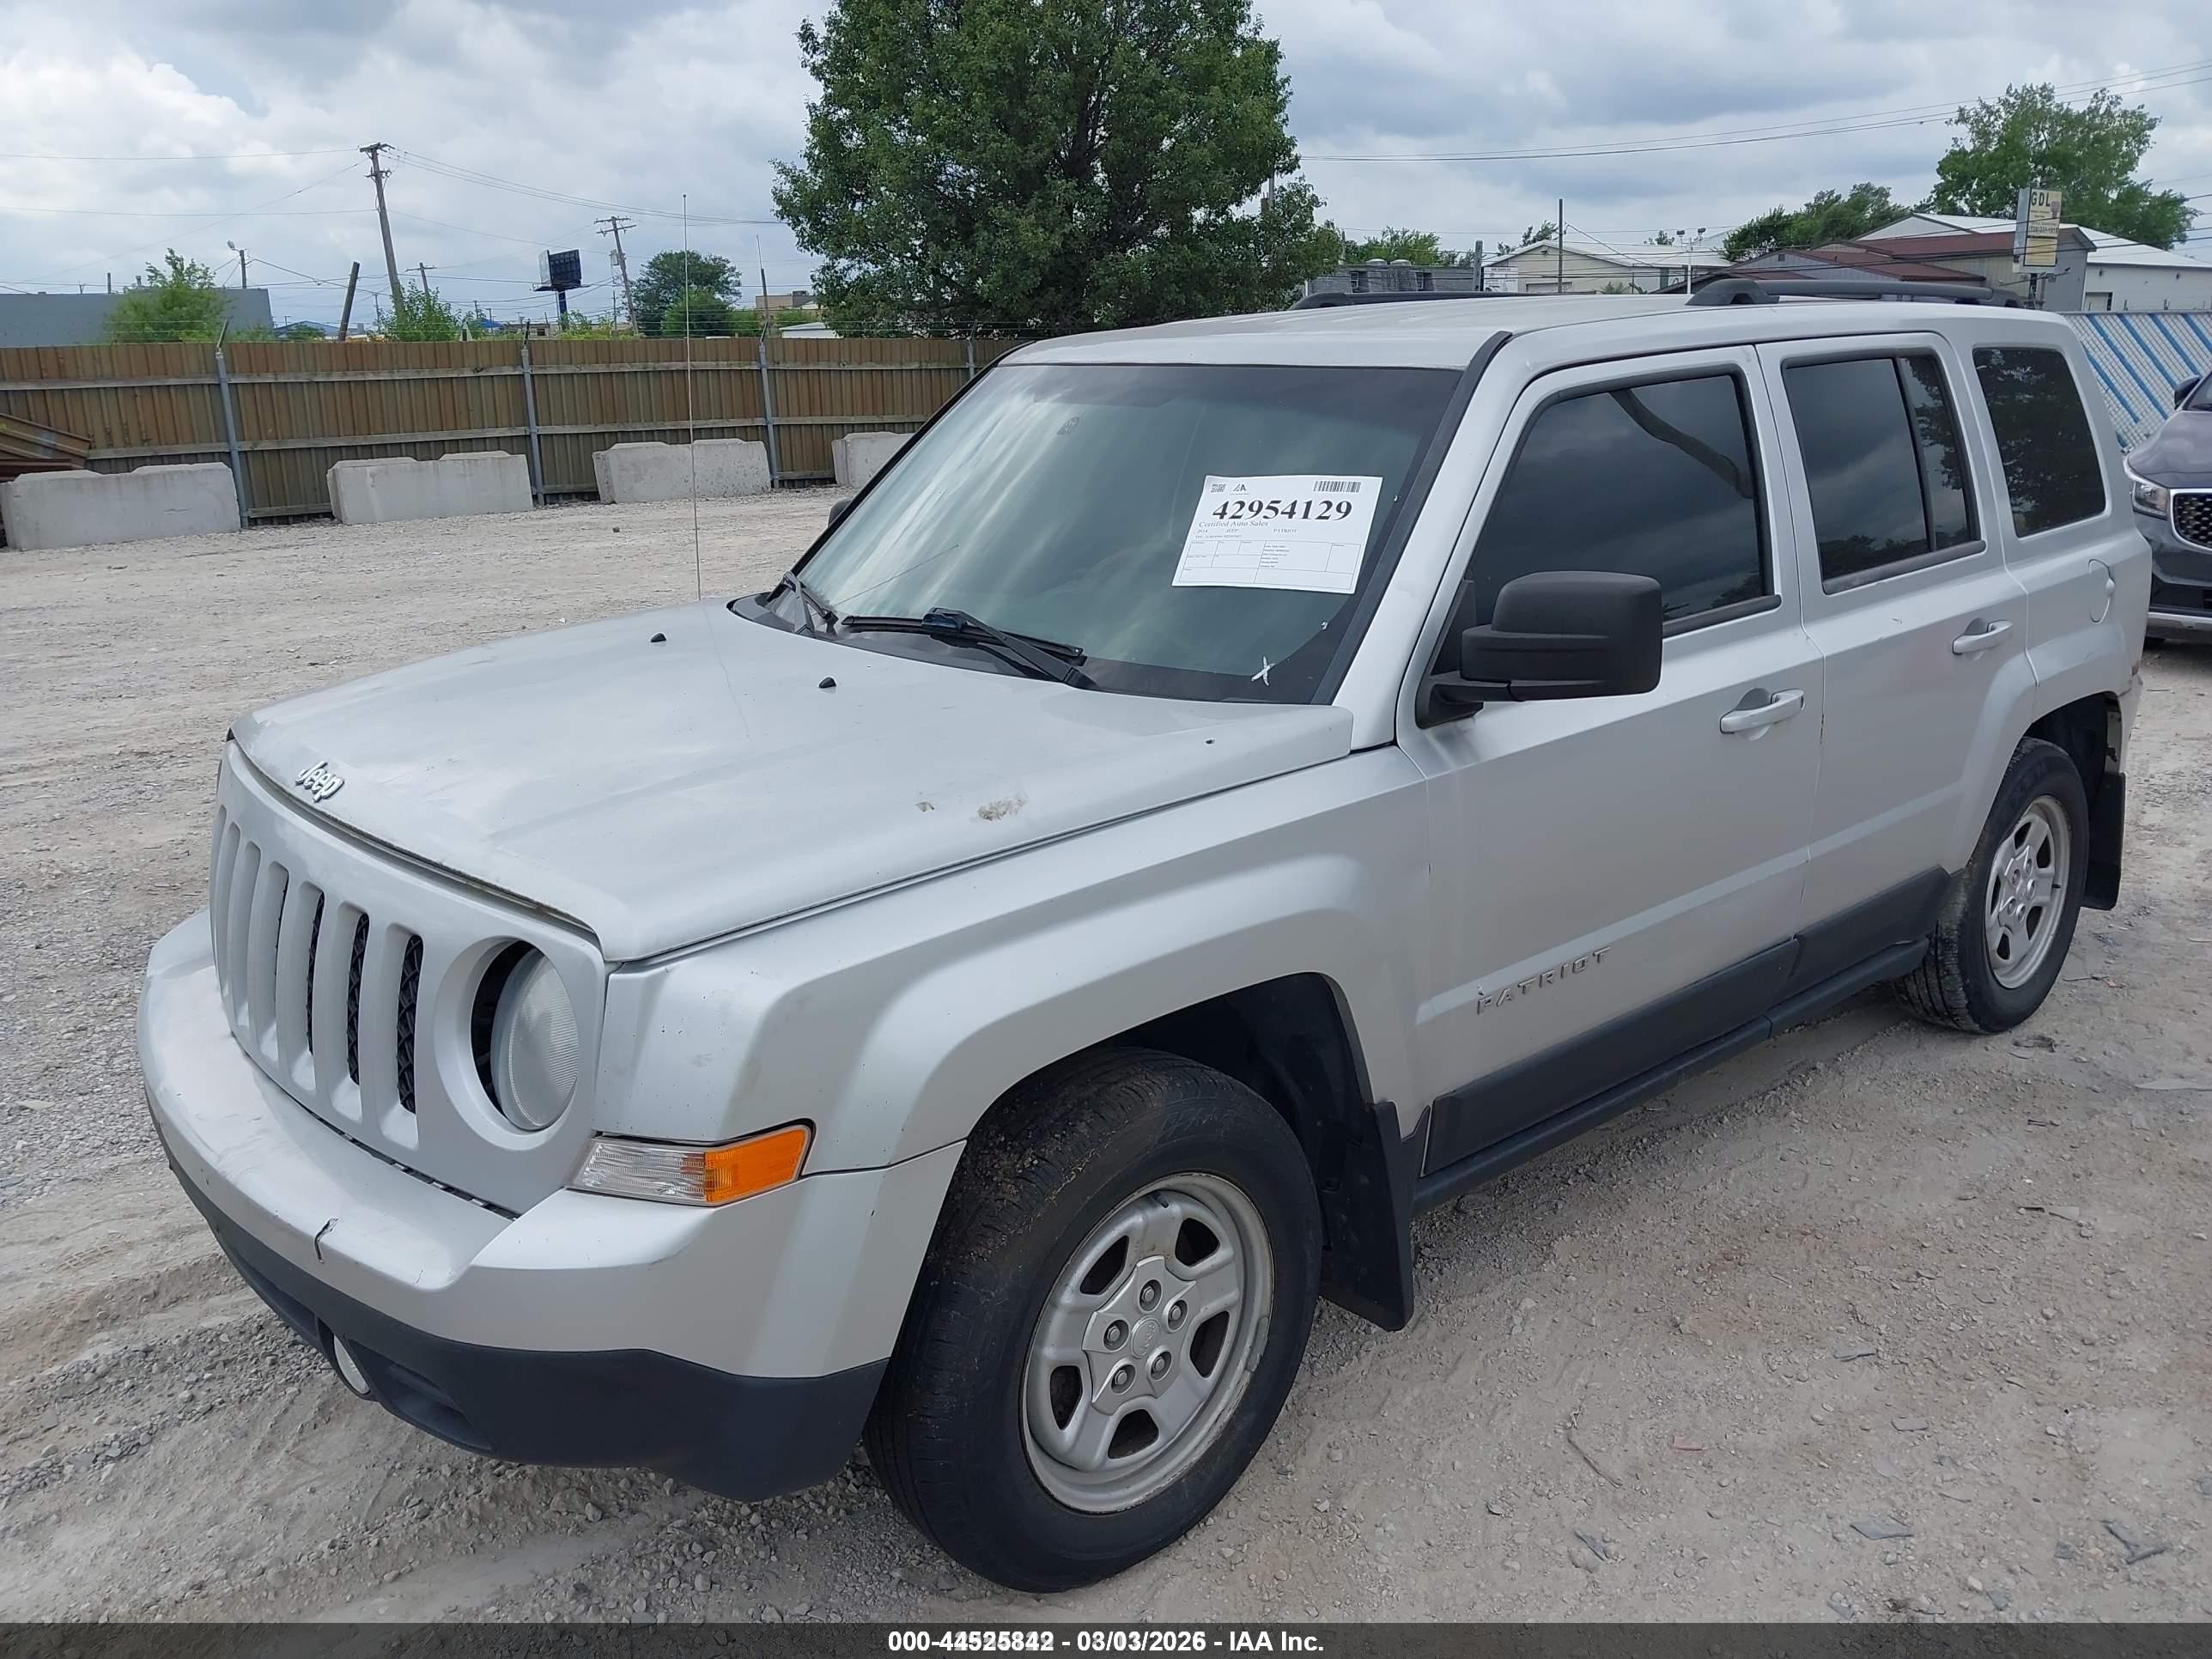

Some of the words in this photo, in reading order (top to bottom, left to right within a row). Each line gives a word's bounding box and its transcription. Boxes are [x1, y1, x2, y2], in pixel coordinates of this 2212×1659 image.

[2031, 191, 2051, 207] GDL
[1212, 500, 1352, 520] 42954129
[295, 761, 344, 803] Jeep
[1476, 945, 1611, 1014] PATRIOT
